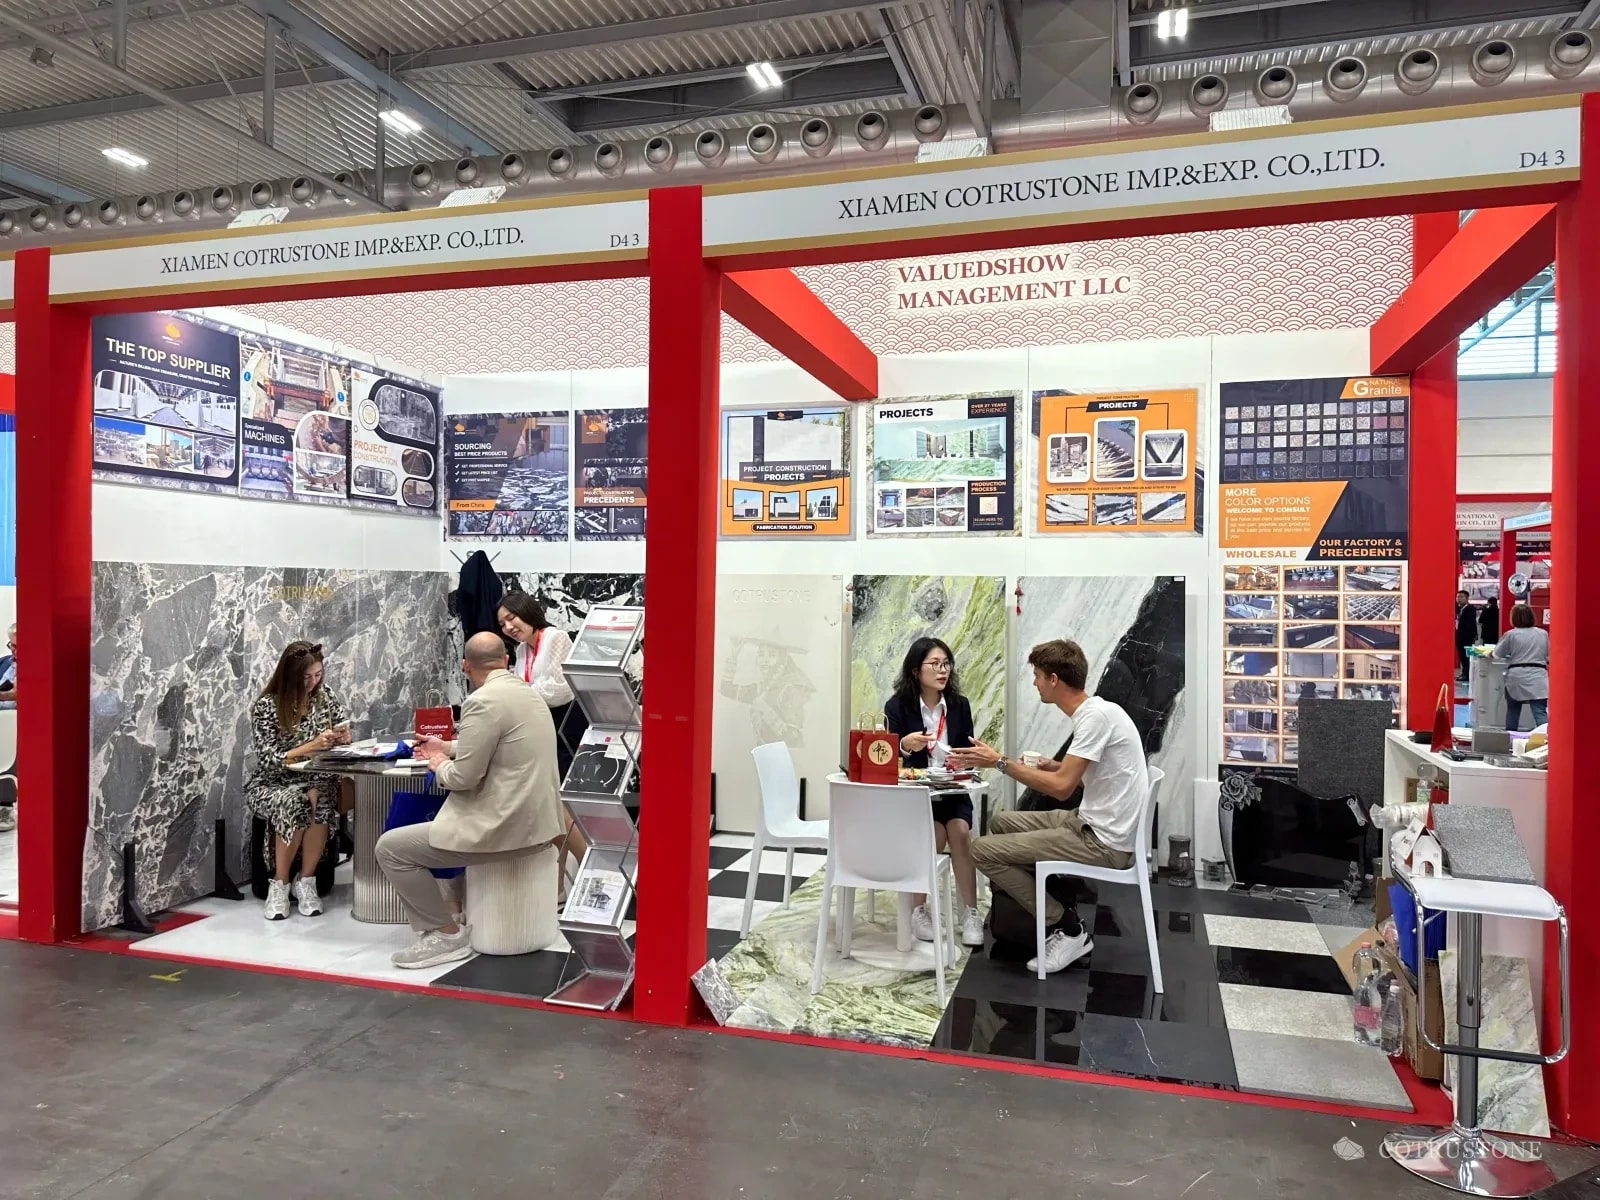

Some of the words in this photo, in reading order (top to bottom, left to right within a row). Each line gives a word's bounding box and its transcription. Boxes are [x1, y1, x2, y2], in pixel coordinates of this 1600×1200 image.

[838, 190, 939, 220] XIAMEN
[945, 171, 1119, 209] COTRUSTONE
[1127, 157, 1259, 192] IMP.&EXP.
[1268, 146, 1386, 177] CO.,LTD.
[160, 251, 229, 274] XIAMEN
[233, 240, 350, 268] COTRUSTONE
[355, 232, 442, 258] IMP.&EXP.
[447, 226, 524, 250] CO.,LTD.
[897, 253, 1070, 284] VALUEDSHOW
[898, 279, 1077, 310] MANAGEMENT
[1083, 275, 1131, 297] LLC
[106, 337, 136, 357] THE
[139, 345, 167, 364] TOP
[169, 353, 231, 380] SUPPLIER
[971, 406, 1007, 414] EXPERIENCE
[1098, 401, 1138, 409] PROJECTS
[879, 408, 934, 419] PROJECTS
[244, 430, 286, 444] MACHINES
[353, 440, 388, 454] PROJECT
[454, 442, 492, 451] SOURCING
[353, 451, 398, 466] CONSTRUCTION
[743, 465, 774, 473] PROJECT
[775, 464, 827, 472] CONSTRUCTION
[764, 473, 806, 481] PROJECTS
[1225, 487, 1257, 497] MORE
[583, 496, 635, 504] PRECEDENTS
[1225, 497, 1262, 506] COLOR
[1264, 496, 1311, 506] OPTIONS
[1344, 538, 1392, 546] FACTORY
[1394, 538, 1403, 546] &
[1226, 550, 1297, 559] WHOLESALE
[1319, 548, 1403, 557] PRECEDENTS
